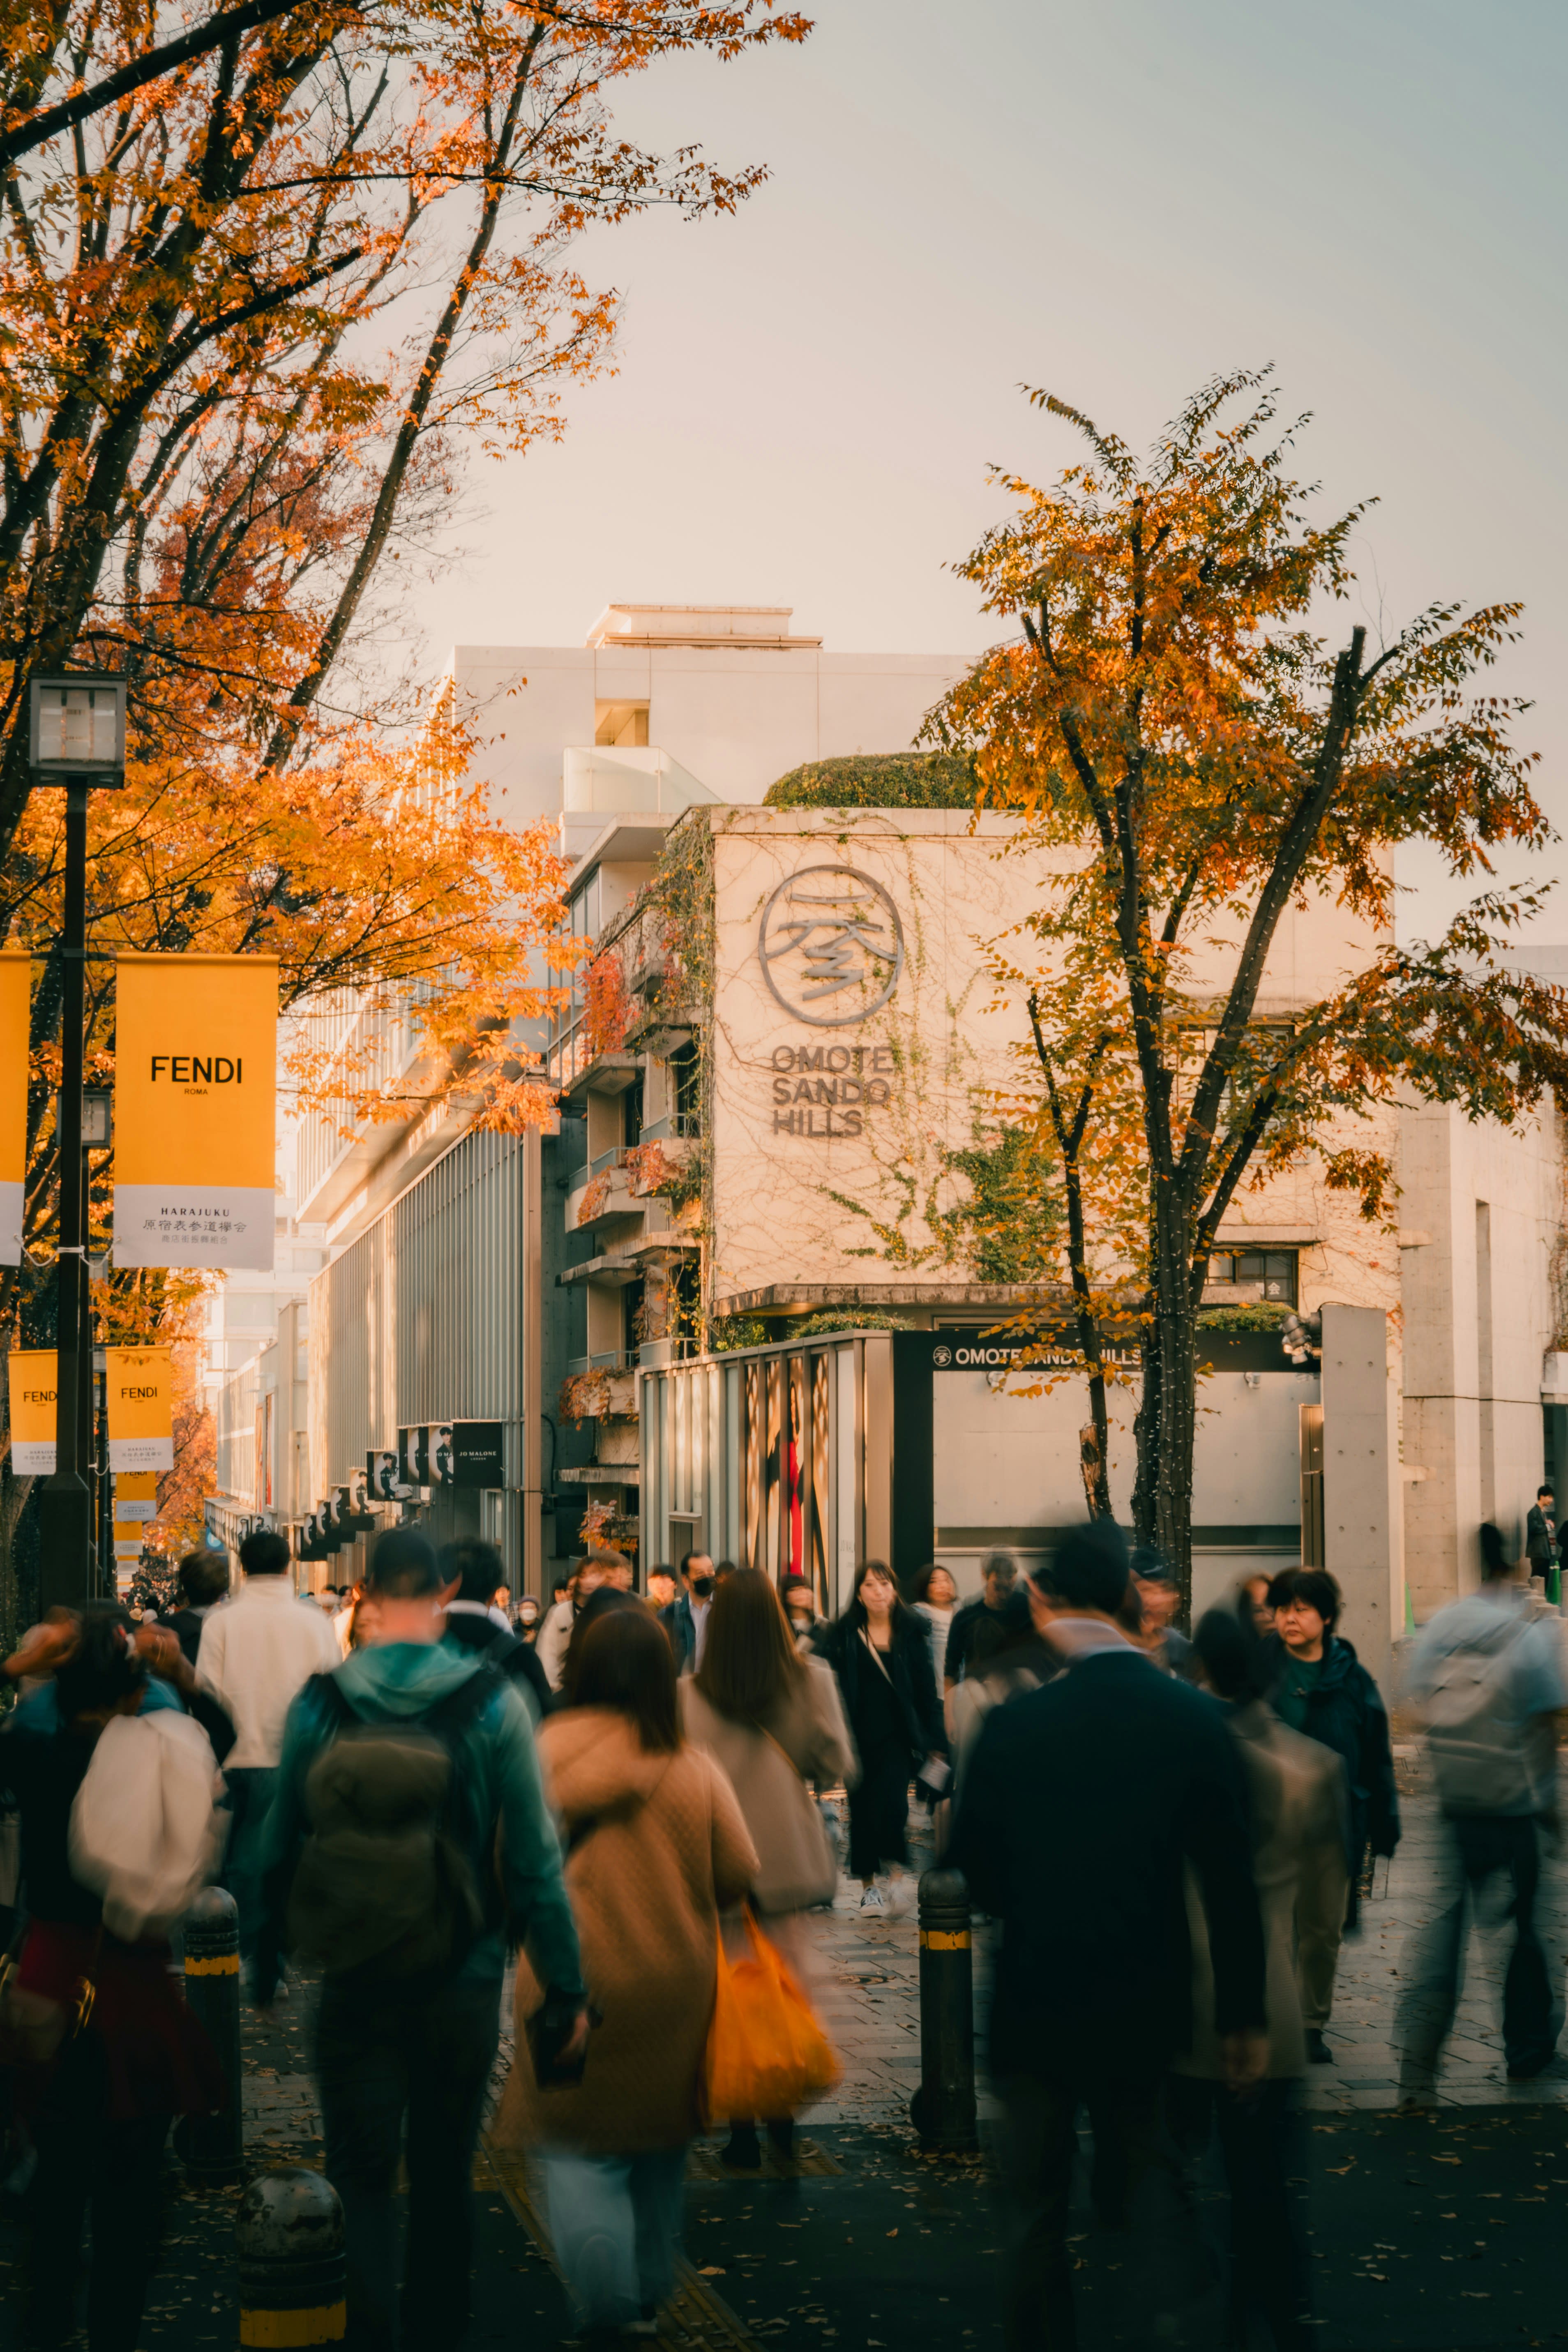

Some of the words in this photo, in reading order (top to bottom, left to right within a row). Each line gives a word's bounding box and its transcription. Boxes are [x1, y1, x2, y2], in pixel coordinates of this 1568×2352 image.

[152, 1056, 242, 1084] FENDI
[772, 1045, 894, 1073] OMOTE
[772, 1078, 891, 1105] SANDO
[773, 1109, 863, 1136] HILLS
[161, 1207, 230, 1217] HARAJUKU
[121, 1387, 157, 1399] FENDI
